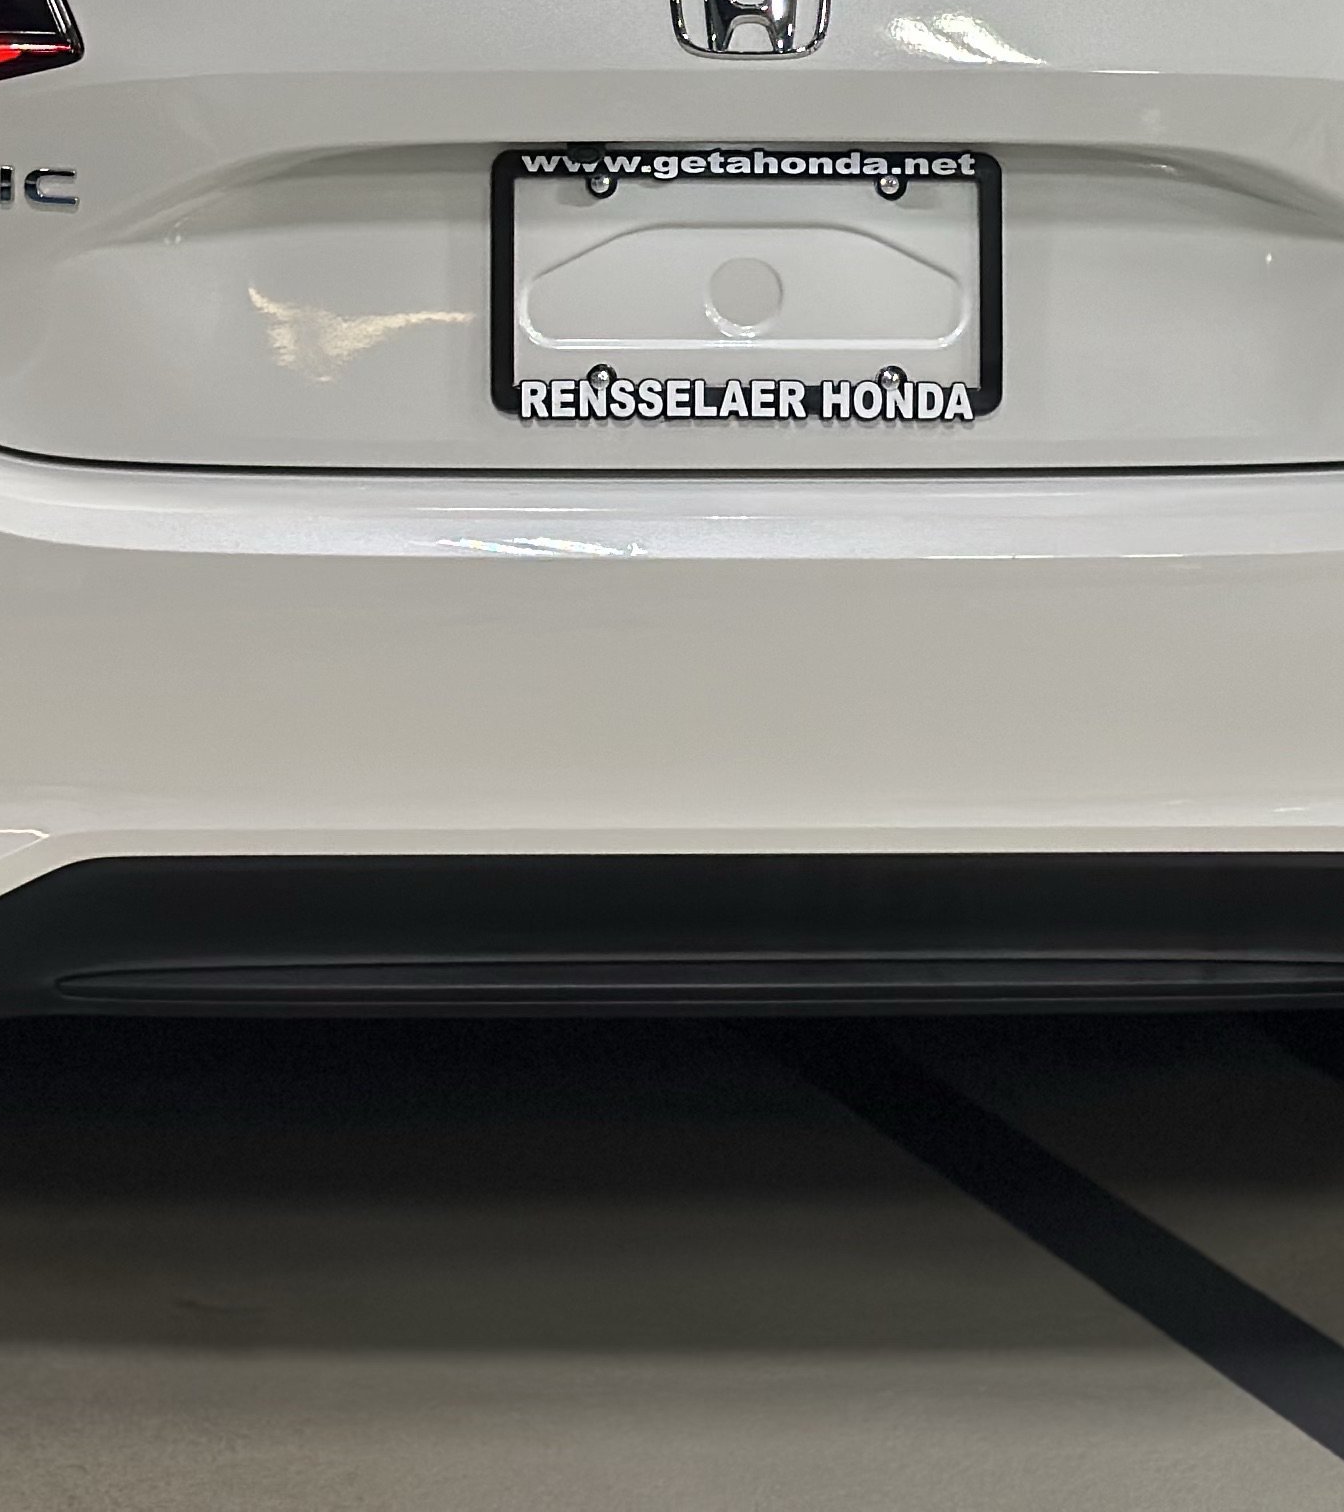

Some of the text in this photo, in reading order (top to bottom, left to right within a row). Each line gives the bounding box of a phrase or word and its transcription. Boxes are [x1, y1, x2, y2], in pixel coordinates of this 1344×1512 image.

[521, 151, 976, 180] www.getahonda.net
[520, 380, 974, 421] RENSSELAER HONDA
